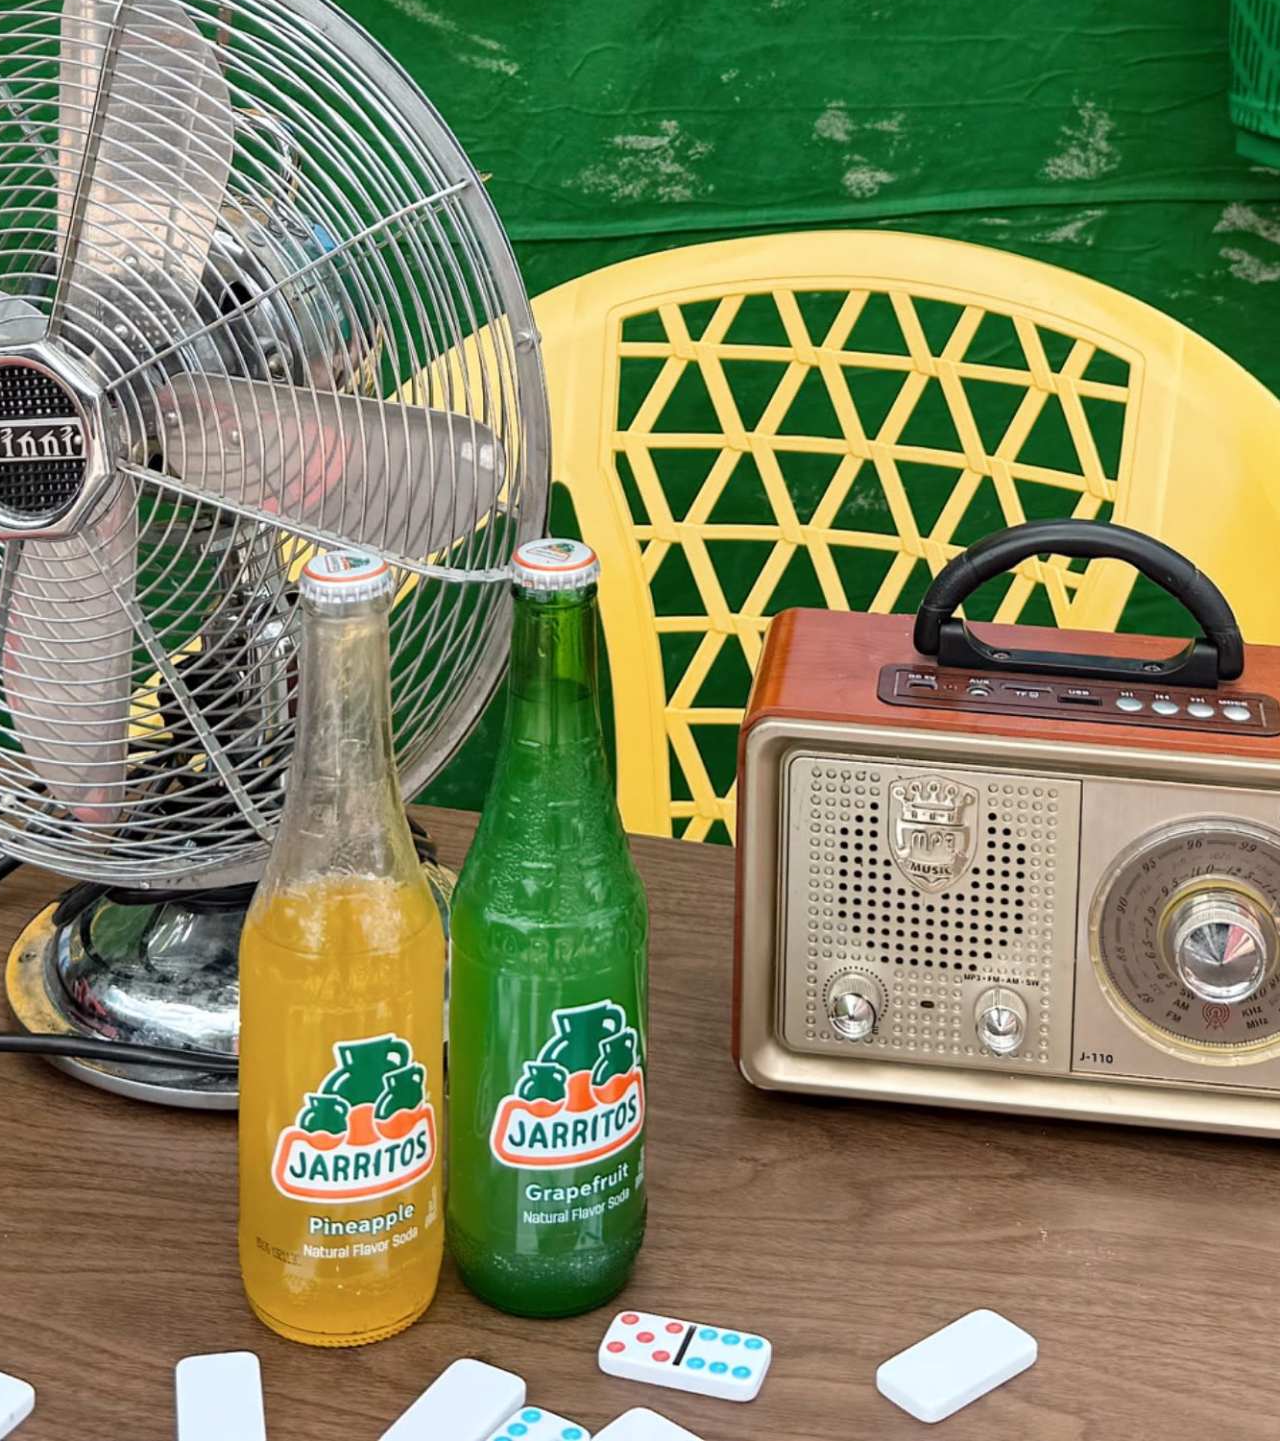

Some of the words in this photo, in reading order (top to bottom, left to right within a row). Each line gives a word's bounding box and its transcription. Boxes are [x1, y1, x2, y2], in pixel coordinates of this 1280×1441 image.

[910, 861, 953, 875] MUSIC
[1166, 1010, 1182, 1023] FM
[1173, 998, 1191, 1012] AM
[1079, 1051, 1114, 1064] J-110
[508, 1094, 637, 1149] JARRITOS
[289, 1130, 427, 1182] JARRITOS
[525, 1163, 629, 1203] Grapefruit
[309, 1203, 415, 1235] Pineapple
[523, 1210, 569, 1224] Natural
[572, 1201, 607, 1221] Flavor
[608, 1188, 630, 1209] Soda
[303, 1243, 350, 1259] Natural
[352, 1239, 389, 1257] Flavor
[392, 1226, 418, 1247] Soda
